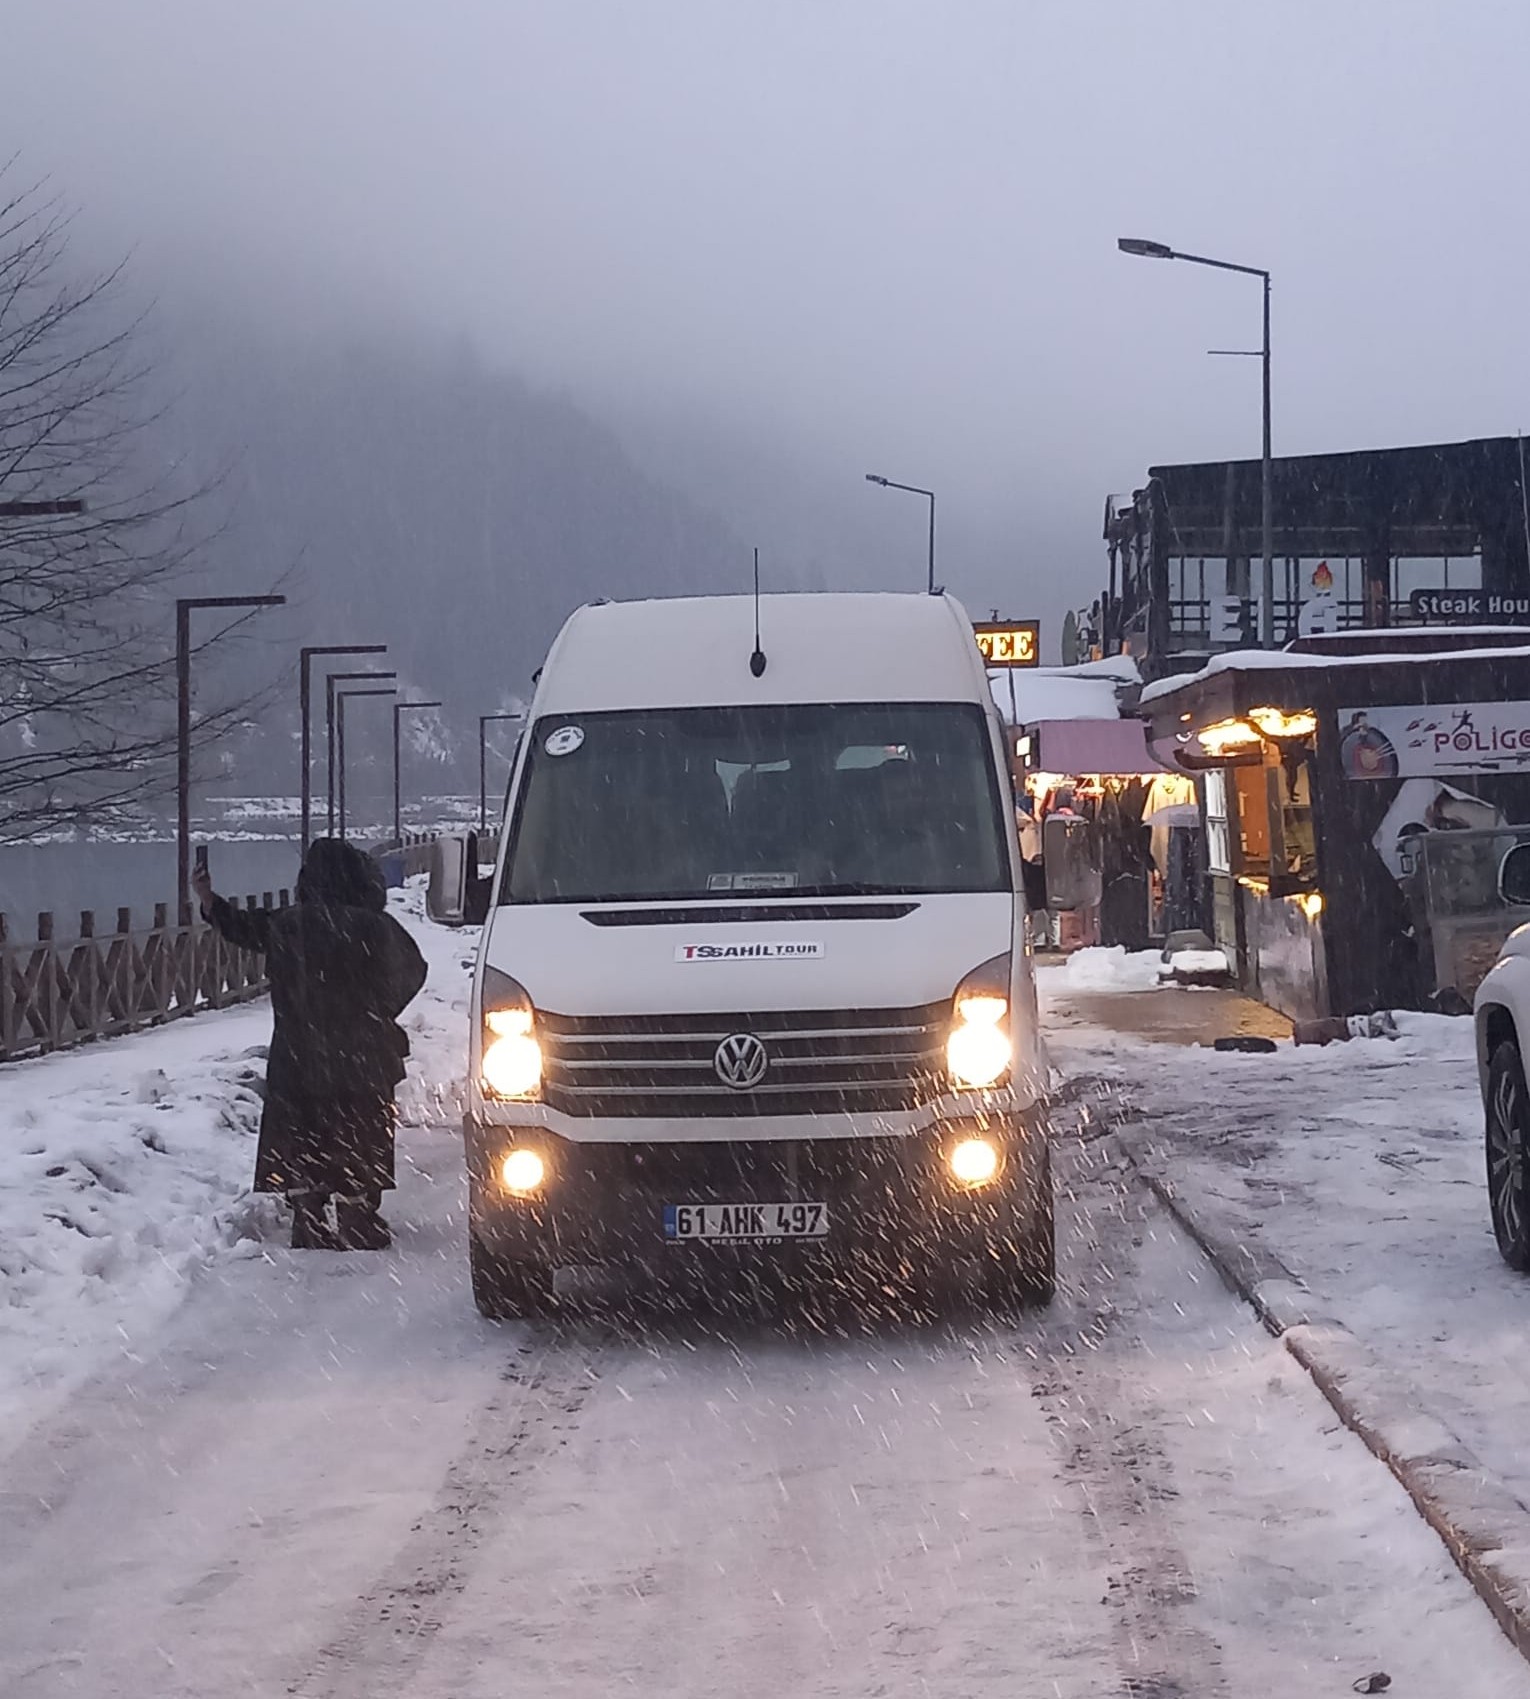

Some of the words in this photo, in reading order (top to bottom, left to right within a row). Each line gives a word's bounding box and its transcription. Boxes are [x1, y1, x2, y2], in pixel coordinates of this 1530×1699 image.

[1418, 596, 1480, 614] Steak
[1488, 596, 1529, 613] Hou
[678, 1207, 706, 1235] 61
[719, 1206, 765, 1235] AHK
[776, 1206, 822, 1234] 497
